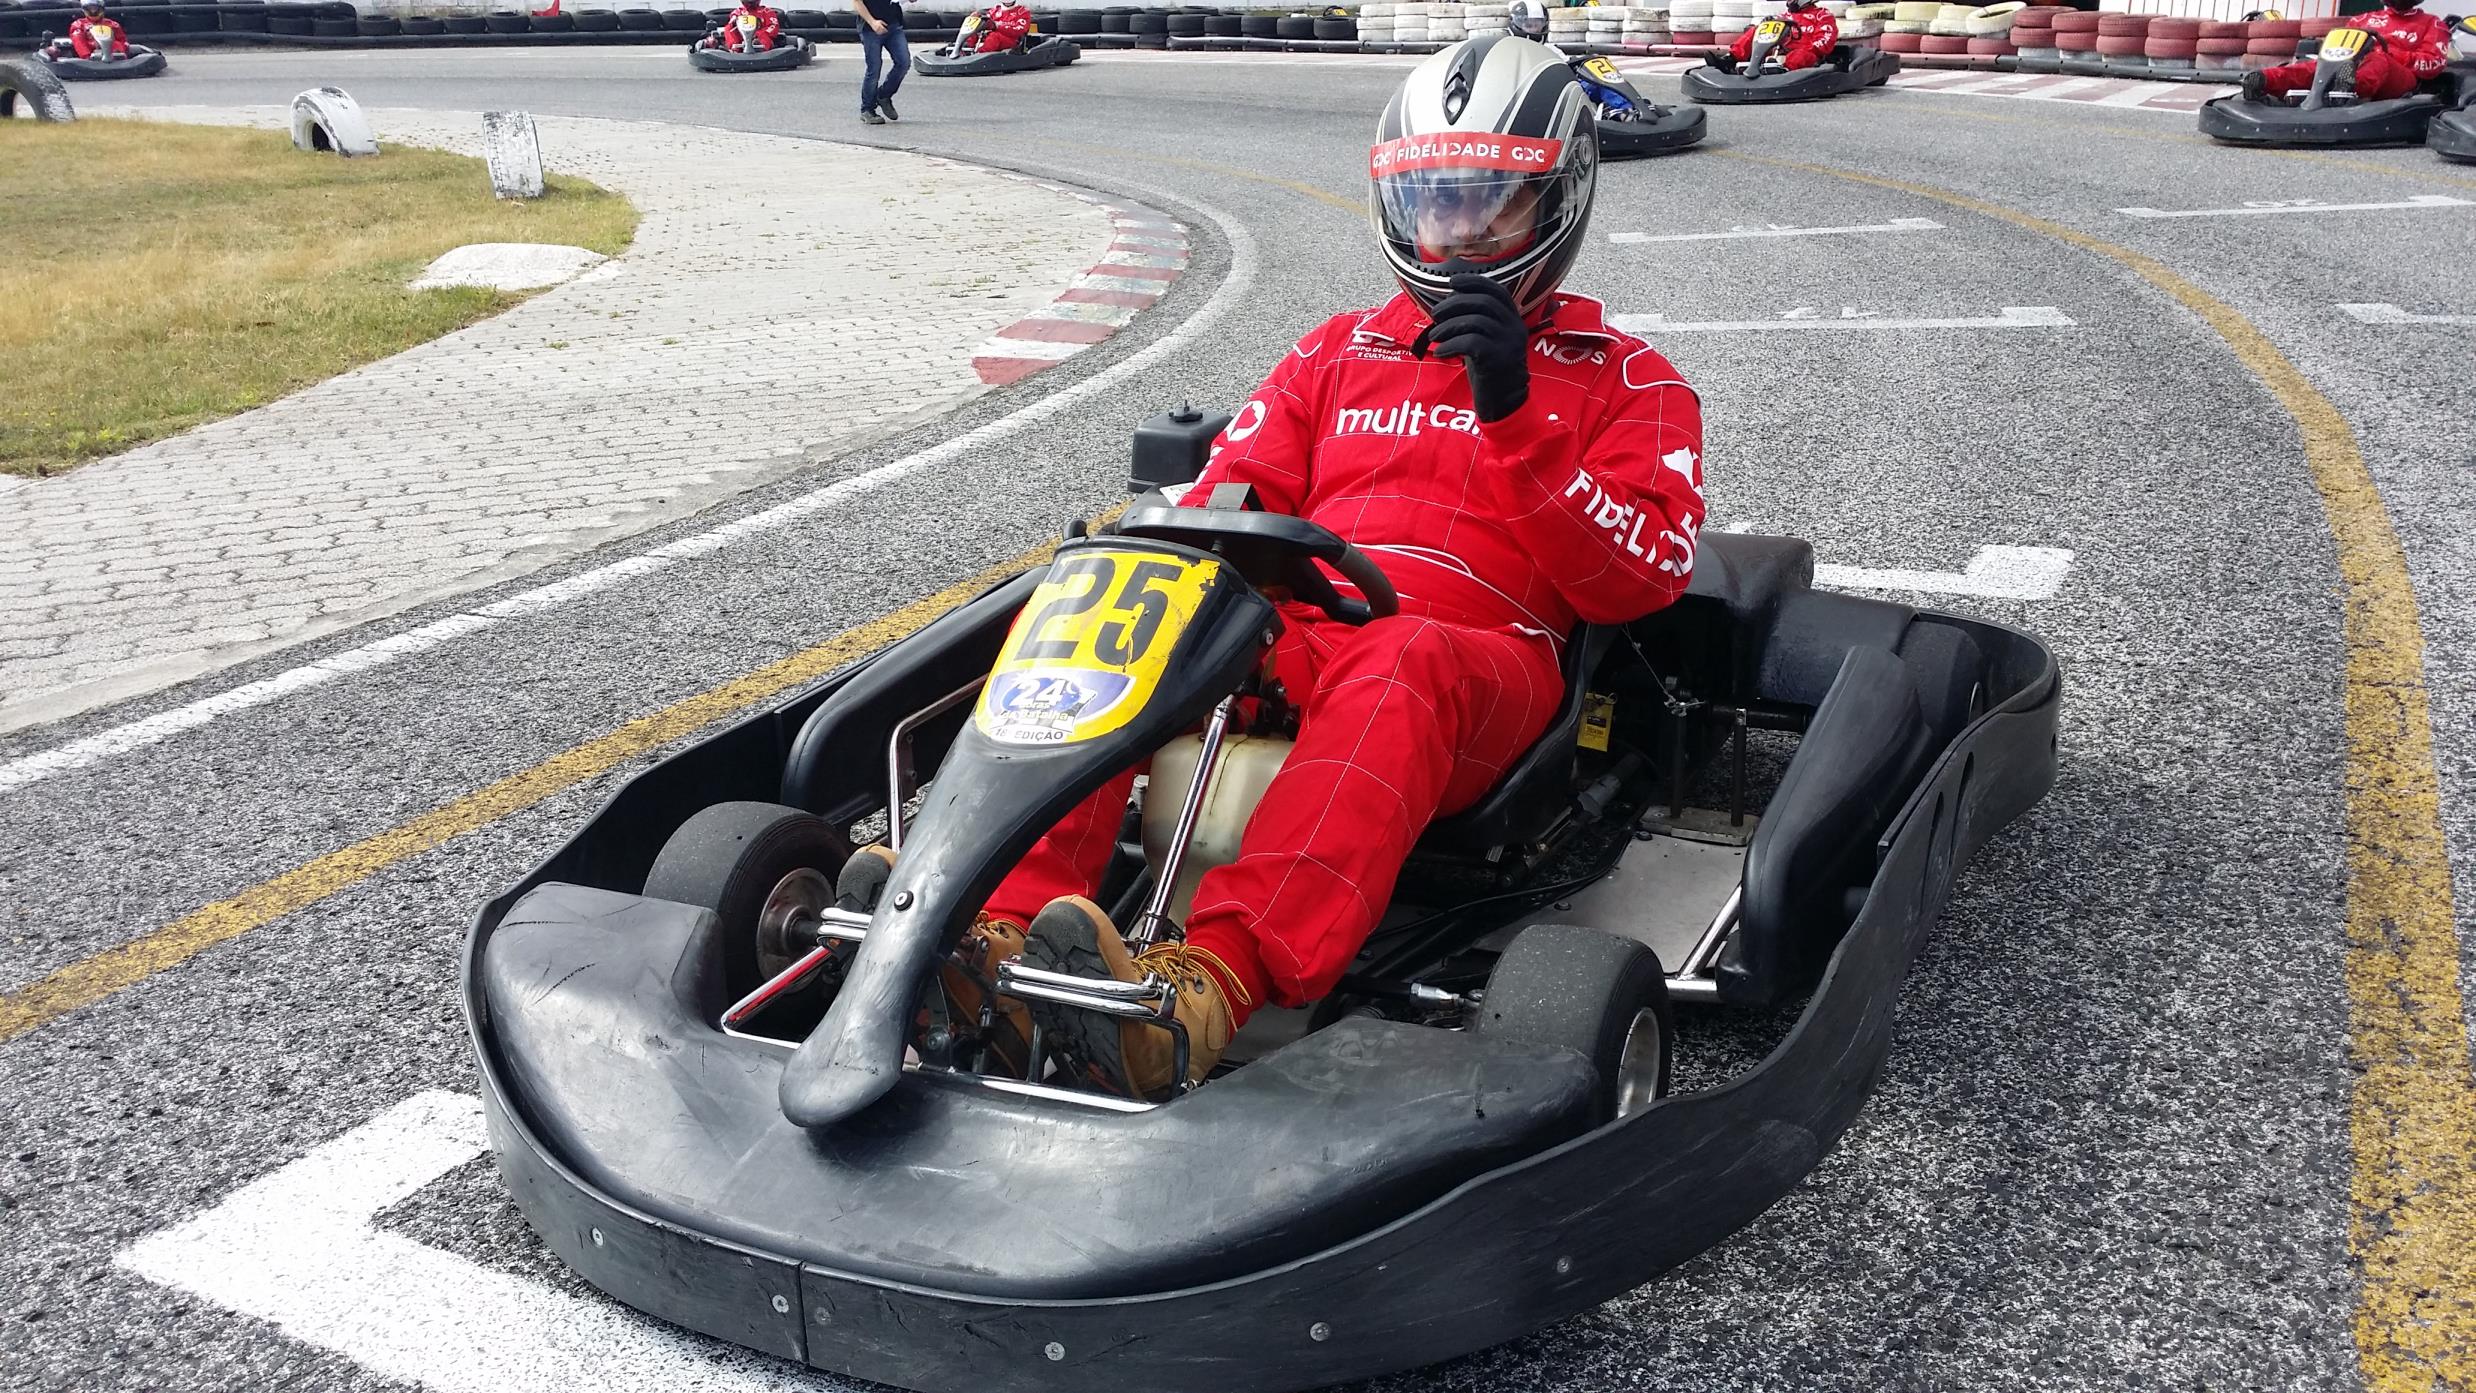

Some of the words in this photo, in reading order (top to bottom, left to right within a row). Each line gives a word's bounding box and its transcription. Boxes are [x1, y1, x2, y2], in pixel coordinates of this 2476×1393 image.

[1760, 23, 1782, 35] 26
[2340, 31, 2361, 48] 11
[1373, 150, 1392, 168] GDC
[1397, 143, 1500, 163] FIDELIDADE
[1511, 146, 1545, 163] GDC
[1363, 352, 1402, 361] CULTURAL
[1372, 348, 1414, 357] DESPORTIV
[1013, 557, 1184, 666] 25
[1009, 679, 1065, 706] 24
